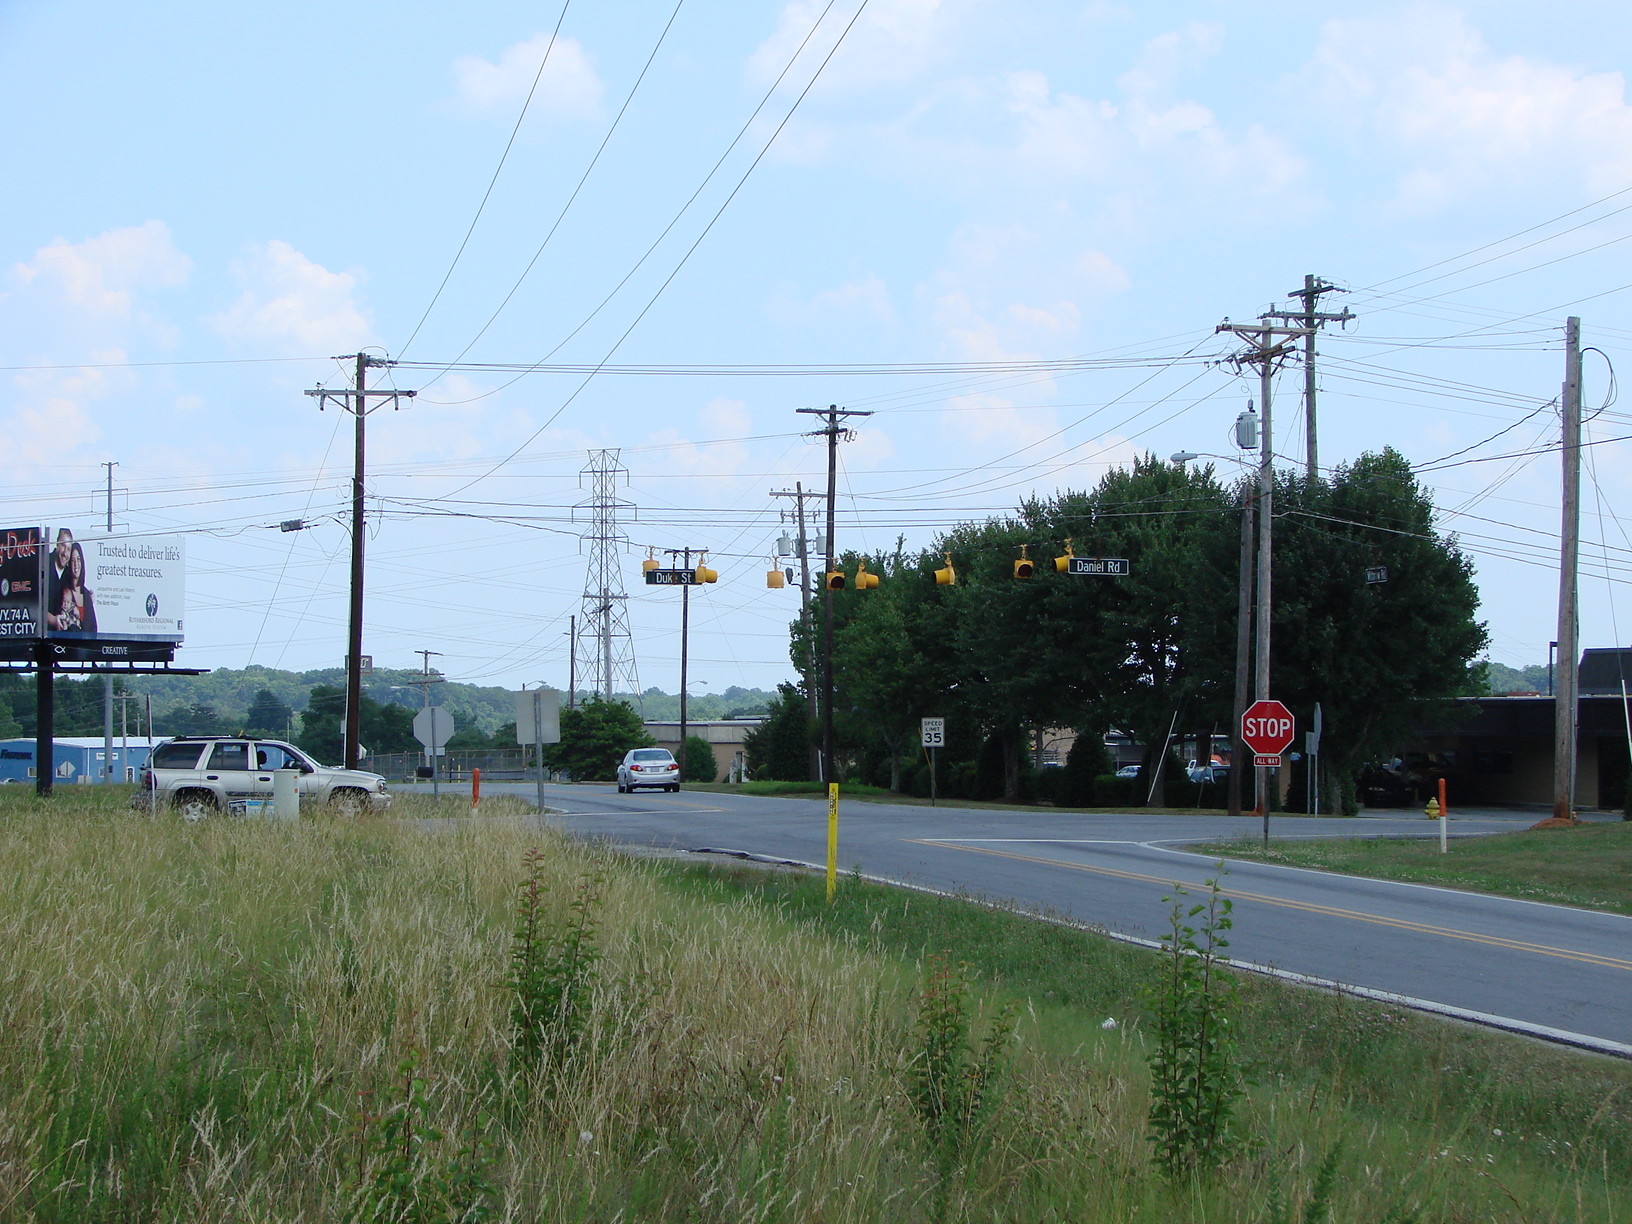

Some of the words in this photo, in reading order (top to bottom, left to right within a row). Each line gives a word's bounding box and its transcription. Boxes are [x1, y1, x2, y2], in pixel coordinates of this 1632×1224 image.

[97, 542, 127, 558] Trusted
[129, 546, 136, 559] to
[138, 545, 164, 560] deliver
[165, 546, 180, 560] life's
[97, 564, 127, 580] greatest
[128, 565, 163, 578] treasures.
[1077, 560, 1104, 573] Daniel
[1107, 561, 1120, 573] Rd
[656, 572, 678, 584] Duk
[681, 572, 692, 584] St
[11, 580, 32, 593] GMC
[11, 609, 21, 621] 74
[22, 608, 30, 620] A
[14, 622, 36, 634] CITY
[101, 645, 128, 655] CREATIVE
[1245, 717, 1291, 738] STOP
[924, 732, 942, 743] 35
